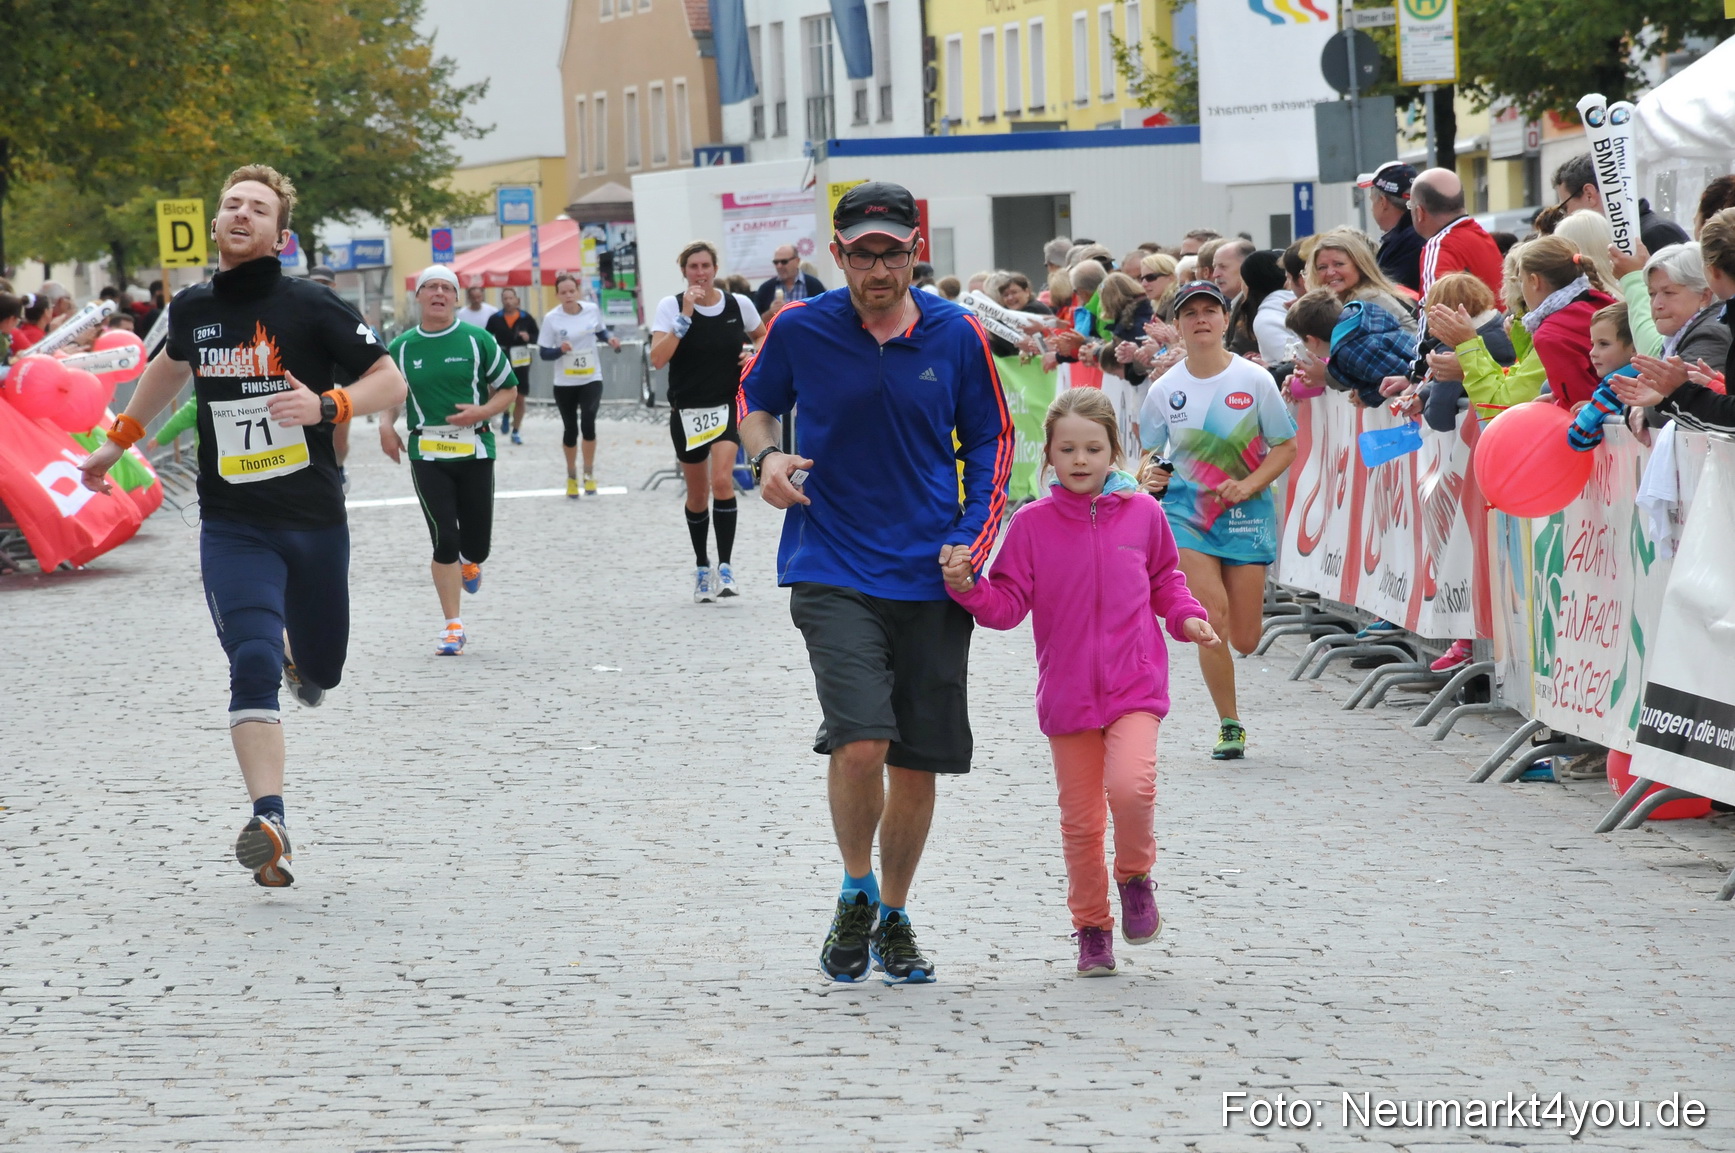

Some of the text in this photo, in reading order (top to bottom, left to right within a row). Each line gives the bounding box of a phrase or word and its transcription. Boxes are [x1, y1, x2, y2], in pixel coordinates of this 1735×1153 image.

[1593, 137, 1620, 186] BMW
[163, 203, 198, 216] Block
[172, 221, 194, 252] D
[197, 327, 216, 340] 2014
[199, 347, 254, 365] TOUGH
[573, 357, 587, 368] 43
[199, 364, 256, 379] MUDDER
[919, 374, 938, 382] adidas
[213, 409, 237, 418] PARTL
[692, 411, 720, 433] 325
[235, 417, 273, 450] 71
[436, 443, 457, 452] Steve
[239, 454, 286, 472] Thomas
[1228, 507, 1247, 519] 16.
[1694, 719, 1717, 745] die
